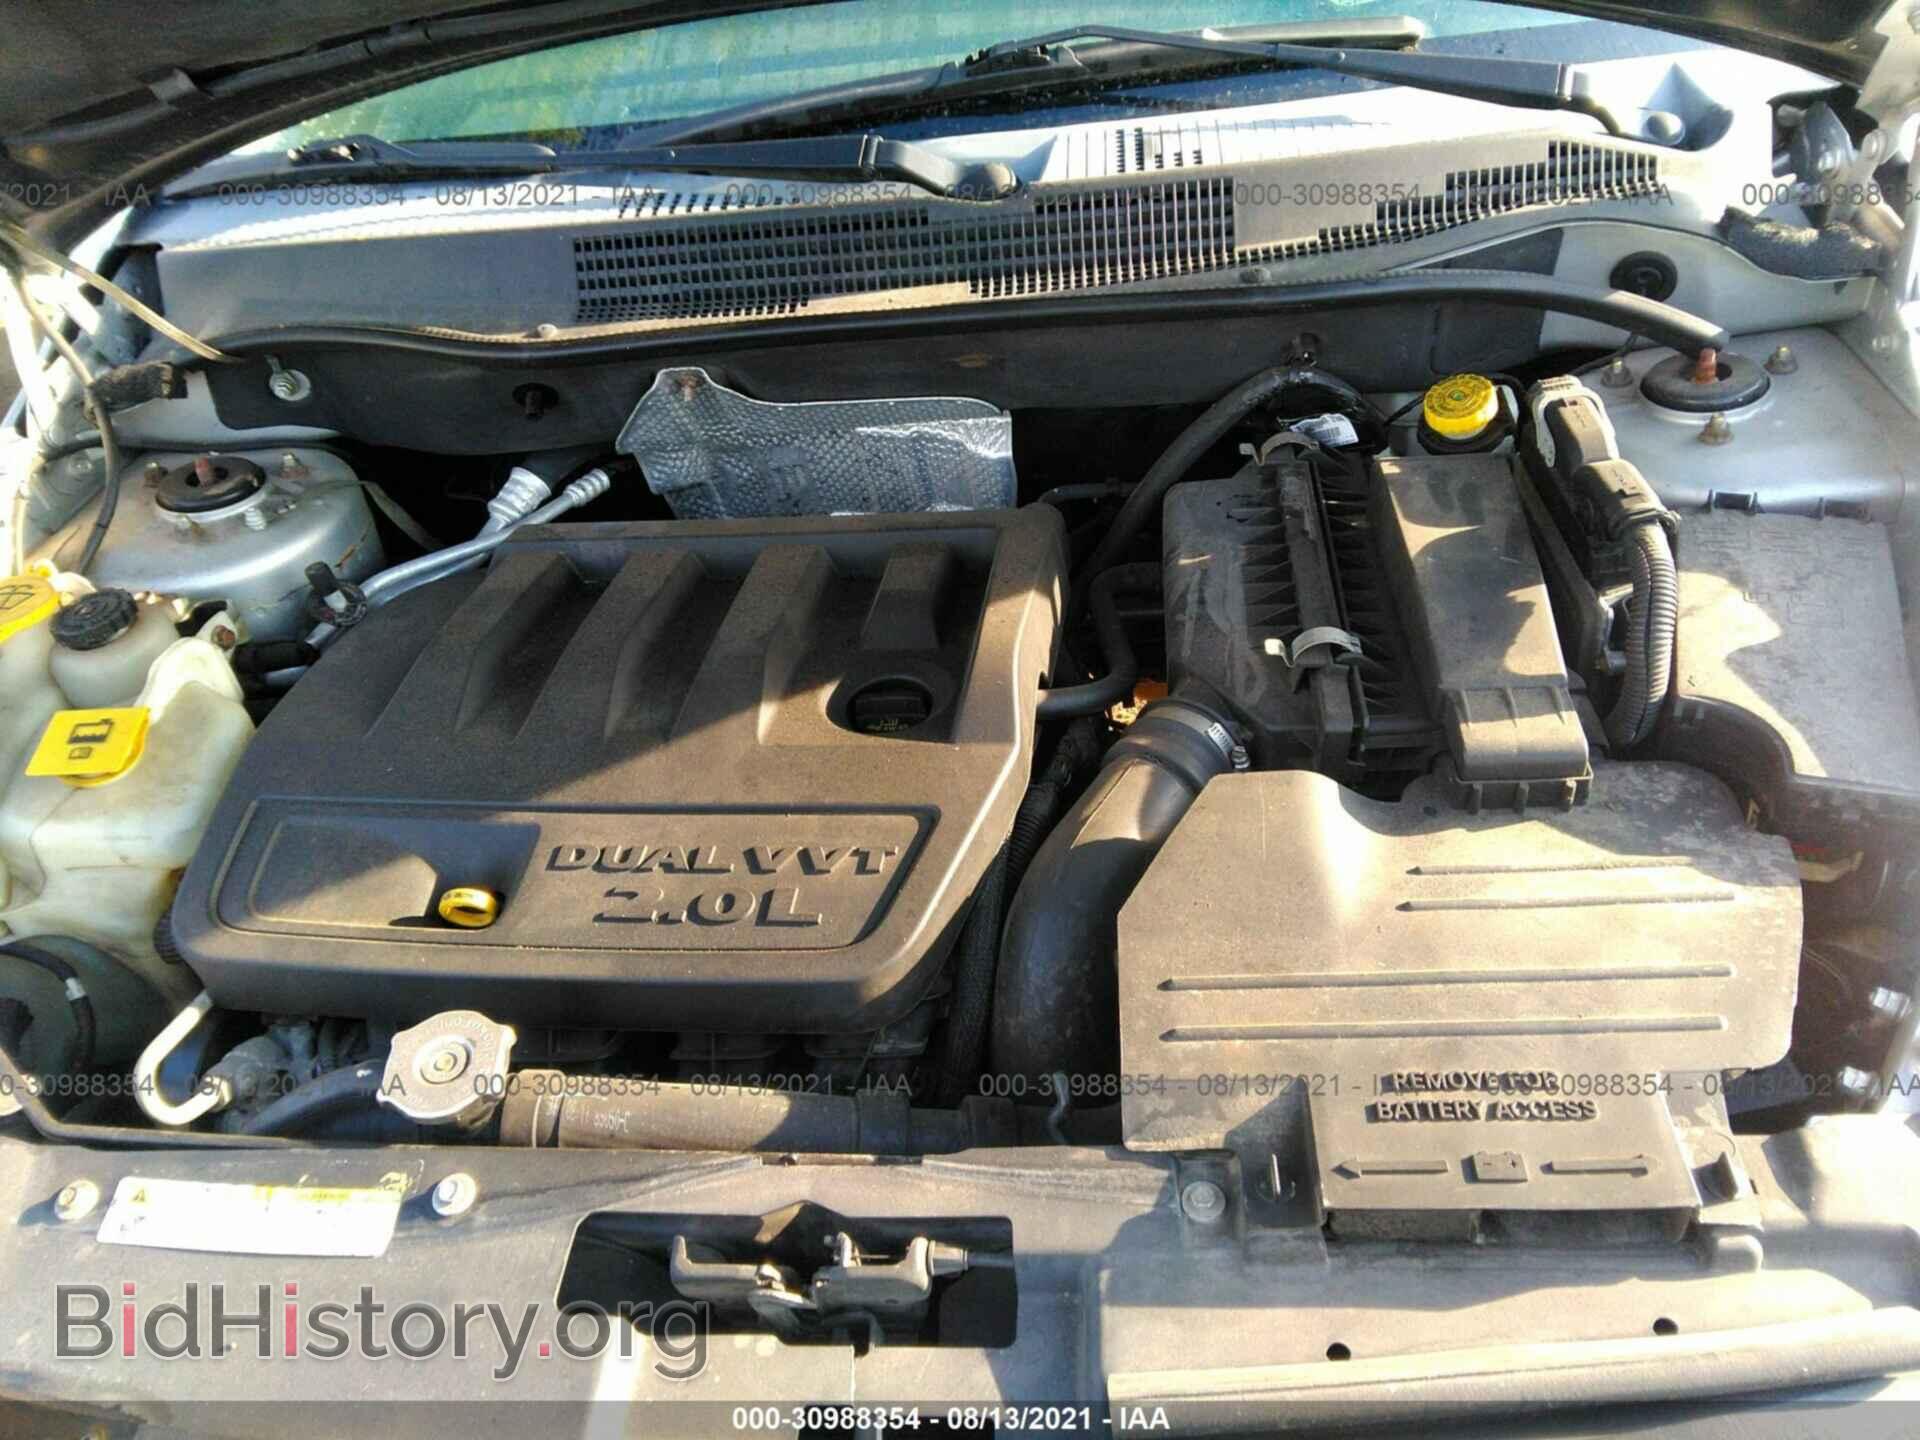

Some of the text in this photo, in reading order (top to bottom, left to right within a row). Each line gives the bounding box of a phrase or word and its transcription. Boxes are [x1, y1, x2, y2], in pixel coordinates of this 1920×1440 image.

[546, 845, 899, 876] DUAL VVT
[592, 886, 824, 927] 2.0L
[1392, 1071, 1499, 1091] REMOVE
[1376, 1100, 1597, 1121] BATTERY ACCESS
